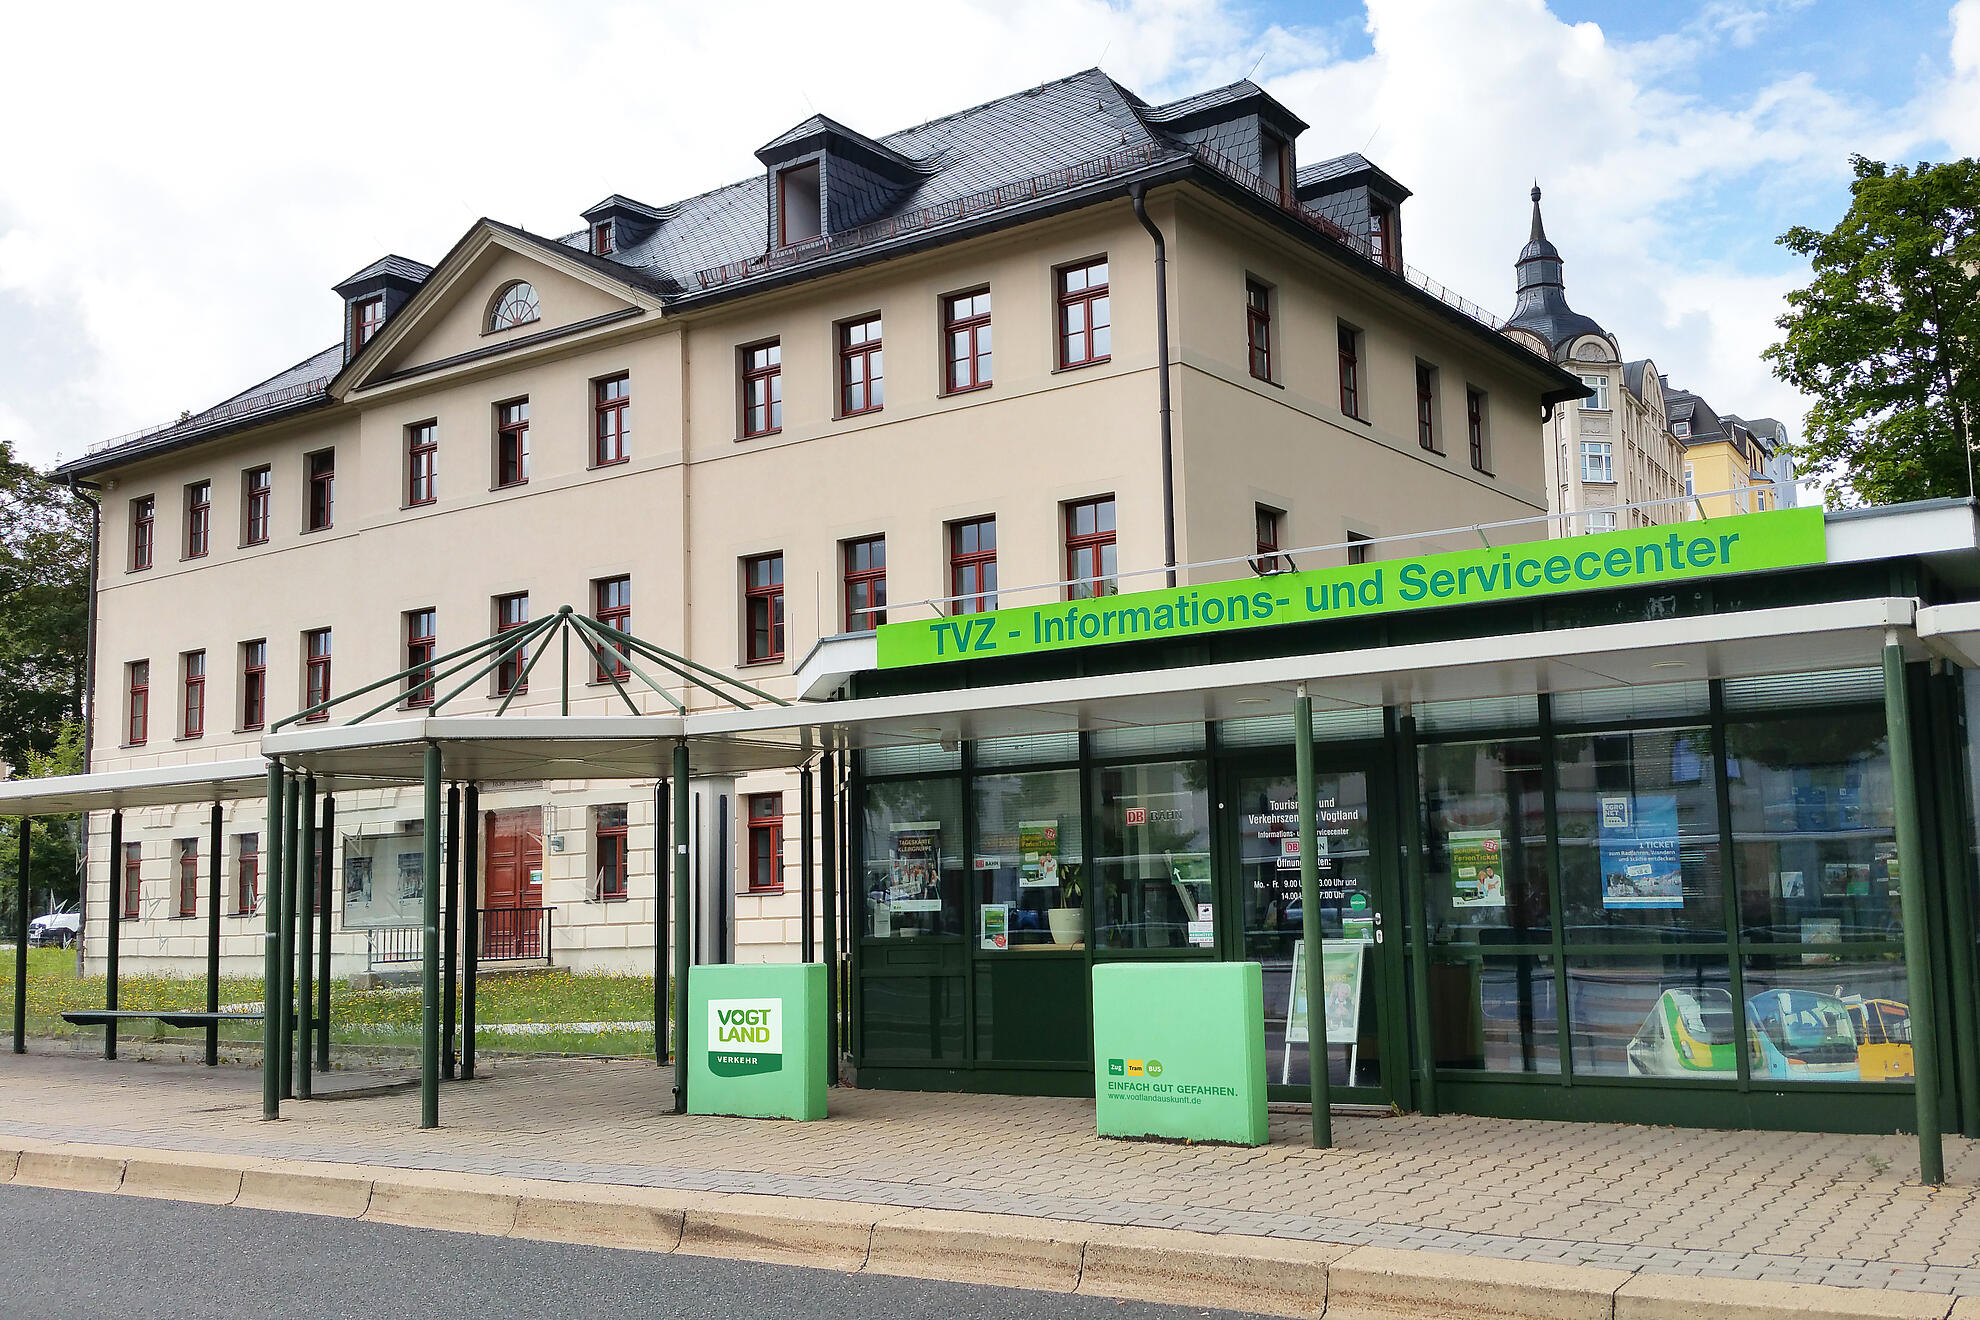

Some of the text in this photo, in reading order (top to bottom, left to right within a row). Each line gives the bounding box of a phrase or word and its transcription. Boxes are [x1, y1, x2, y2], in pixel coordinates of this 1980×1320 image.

[929, 532, 1740, 656] TVZ - Informations- und Servicecenter
[1318, 797, 1335, 808] und
[1127, 809, 1183, 825] DB BAHN
[1320, 810, 1359, 823] Vogtland
[1257, 829, 1296, 839] Informations-
[1316, 828, 1350, 836] rvicecenter
[1286, 842, 1299, 852] DB
[1644, 841, 1675, 849] TICKET
[1283, 879, 1298, 888] 9.00
[1319, 878, 1357, 887] 3.00 Uhr und
[1281, 891, 1298, 900] 14.00
[1319, 890, 1345, 899] 7.00 Uhr
[717, 1009, 771, 1026] VOGT
[718, 1026, 770, 1043] LAND
[716, 1055, 758, 1065] VERKEHR
[1110, 1063, 1122, 1072] Zug
[1148, 1065, 1162, 1073] BUS
[1108, 1081, 1239, 1097] EINFACH GUT GEFAHREN.
[1107, 1092, 1202, 1105] www.vogtlandauskunft.de
